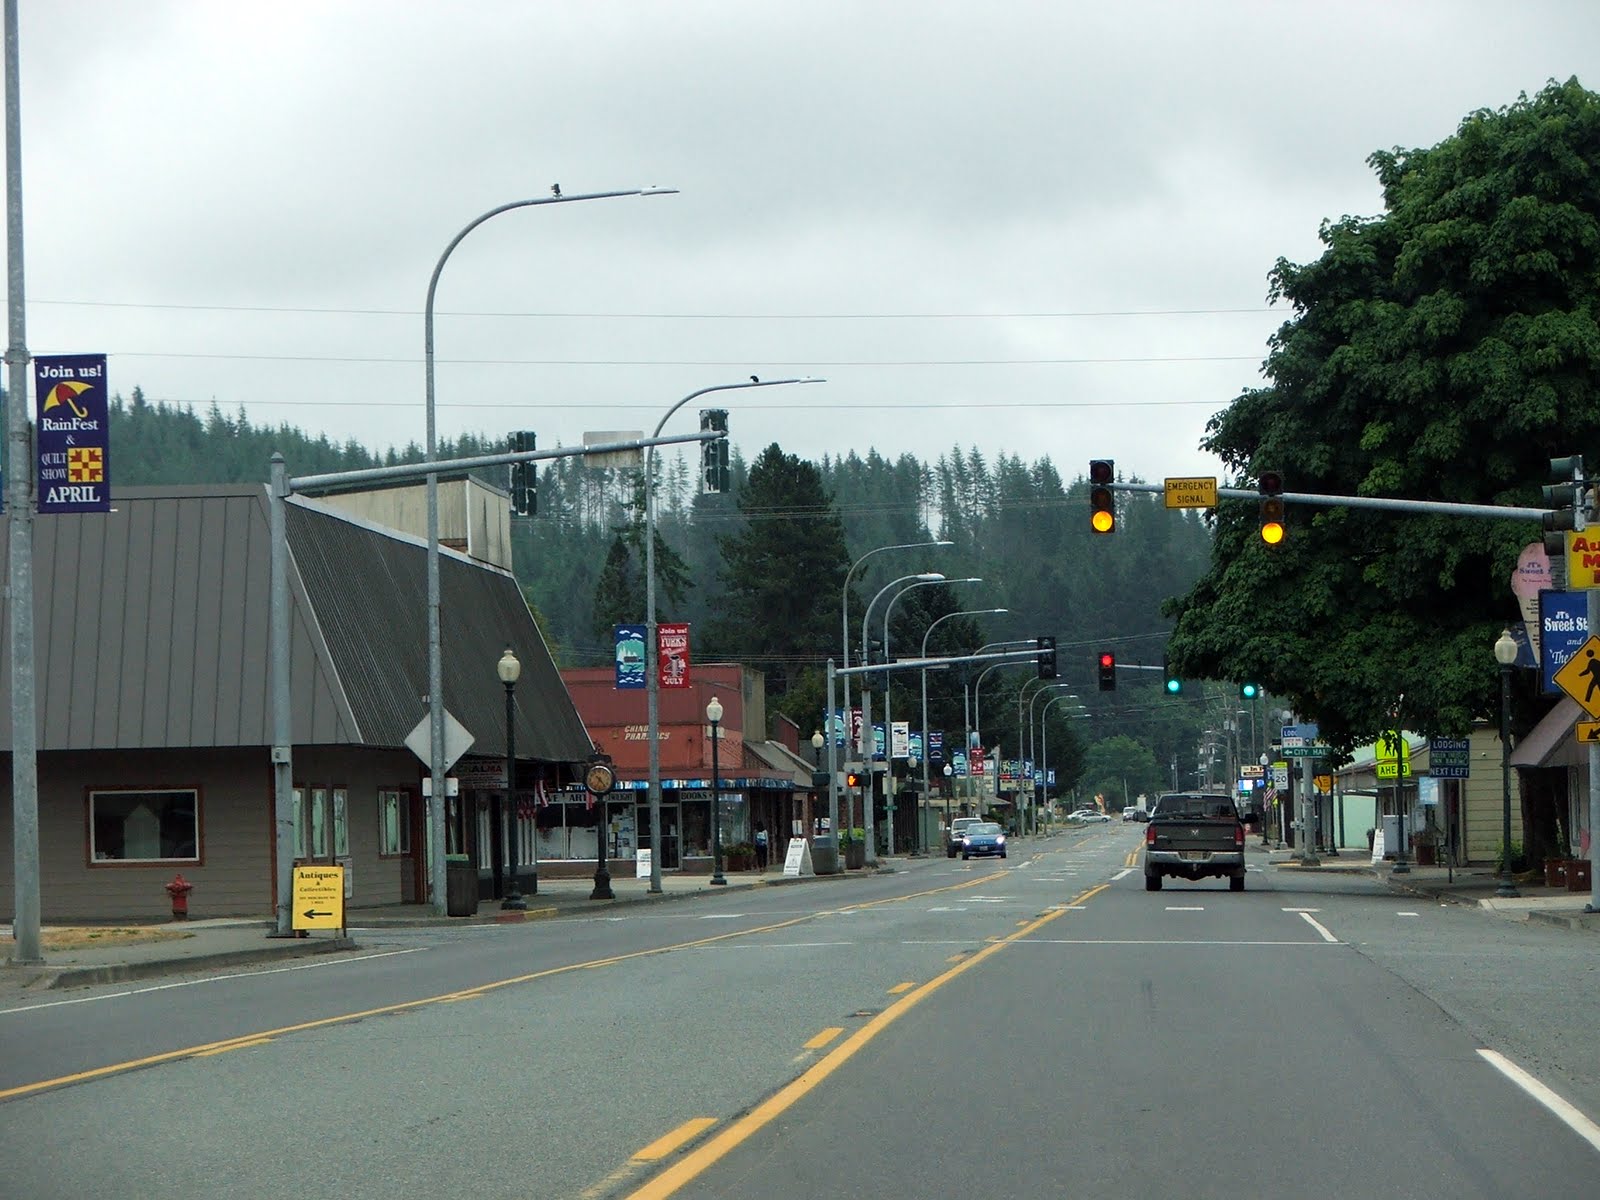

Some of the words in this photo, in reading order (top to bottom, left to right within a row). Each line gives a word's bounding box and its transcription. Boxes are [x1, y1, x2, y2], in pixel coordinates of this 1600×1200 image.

[39, 366, 74, 378] Join
[79, 365, 102, 377] us!
[42, 418, 98, 431] RainFest
[66, 435, 75, 445] &
[41, 453, 67, 465] QUILT
[41, 468, 67, 480] SHOW
[1167, 481, 1213, 491] EMERGENCY
[46, 486, 100, 503] APRIL
[1176, 495, 1205, 503] SIGNAL
[1544, 617, 1575, 632] Sweet
[1566, 637, 1584, 645] and
[664, 677, 683, 685] JULY
[1380, 765, 1407, 774] AHED
[1430, 768, 1448, 776] NEXT
[1451, 767, 1468, 776] LEFT
[681, 791, 707, 800] BOOKS
[298, 872, 338, 880] Antiques
